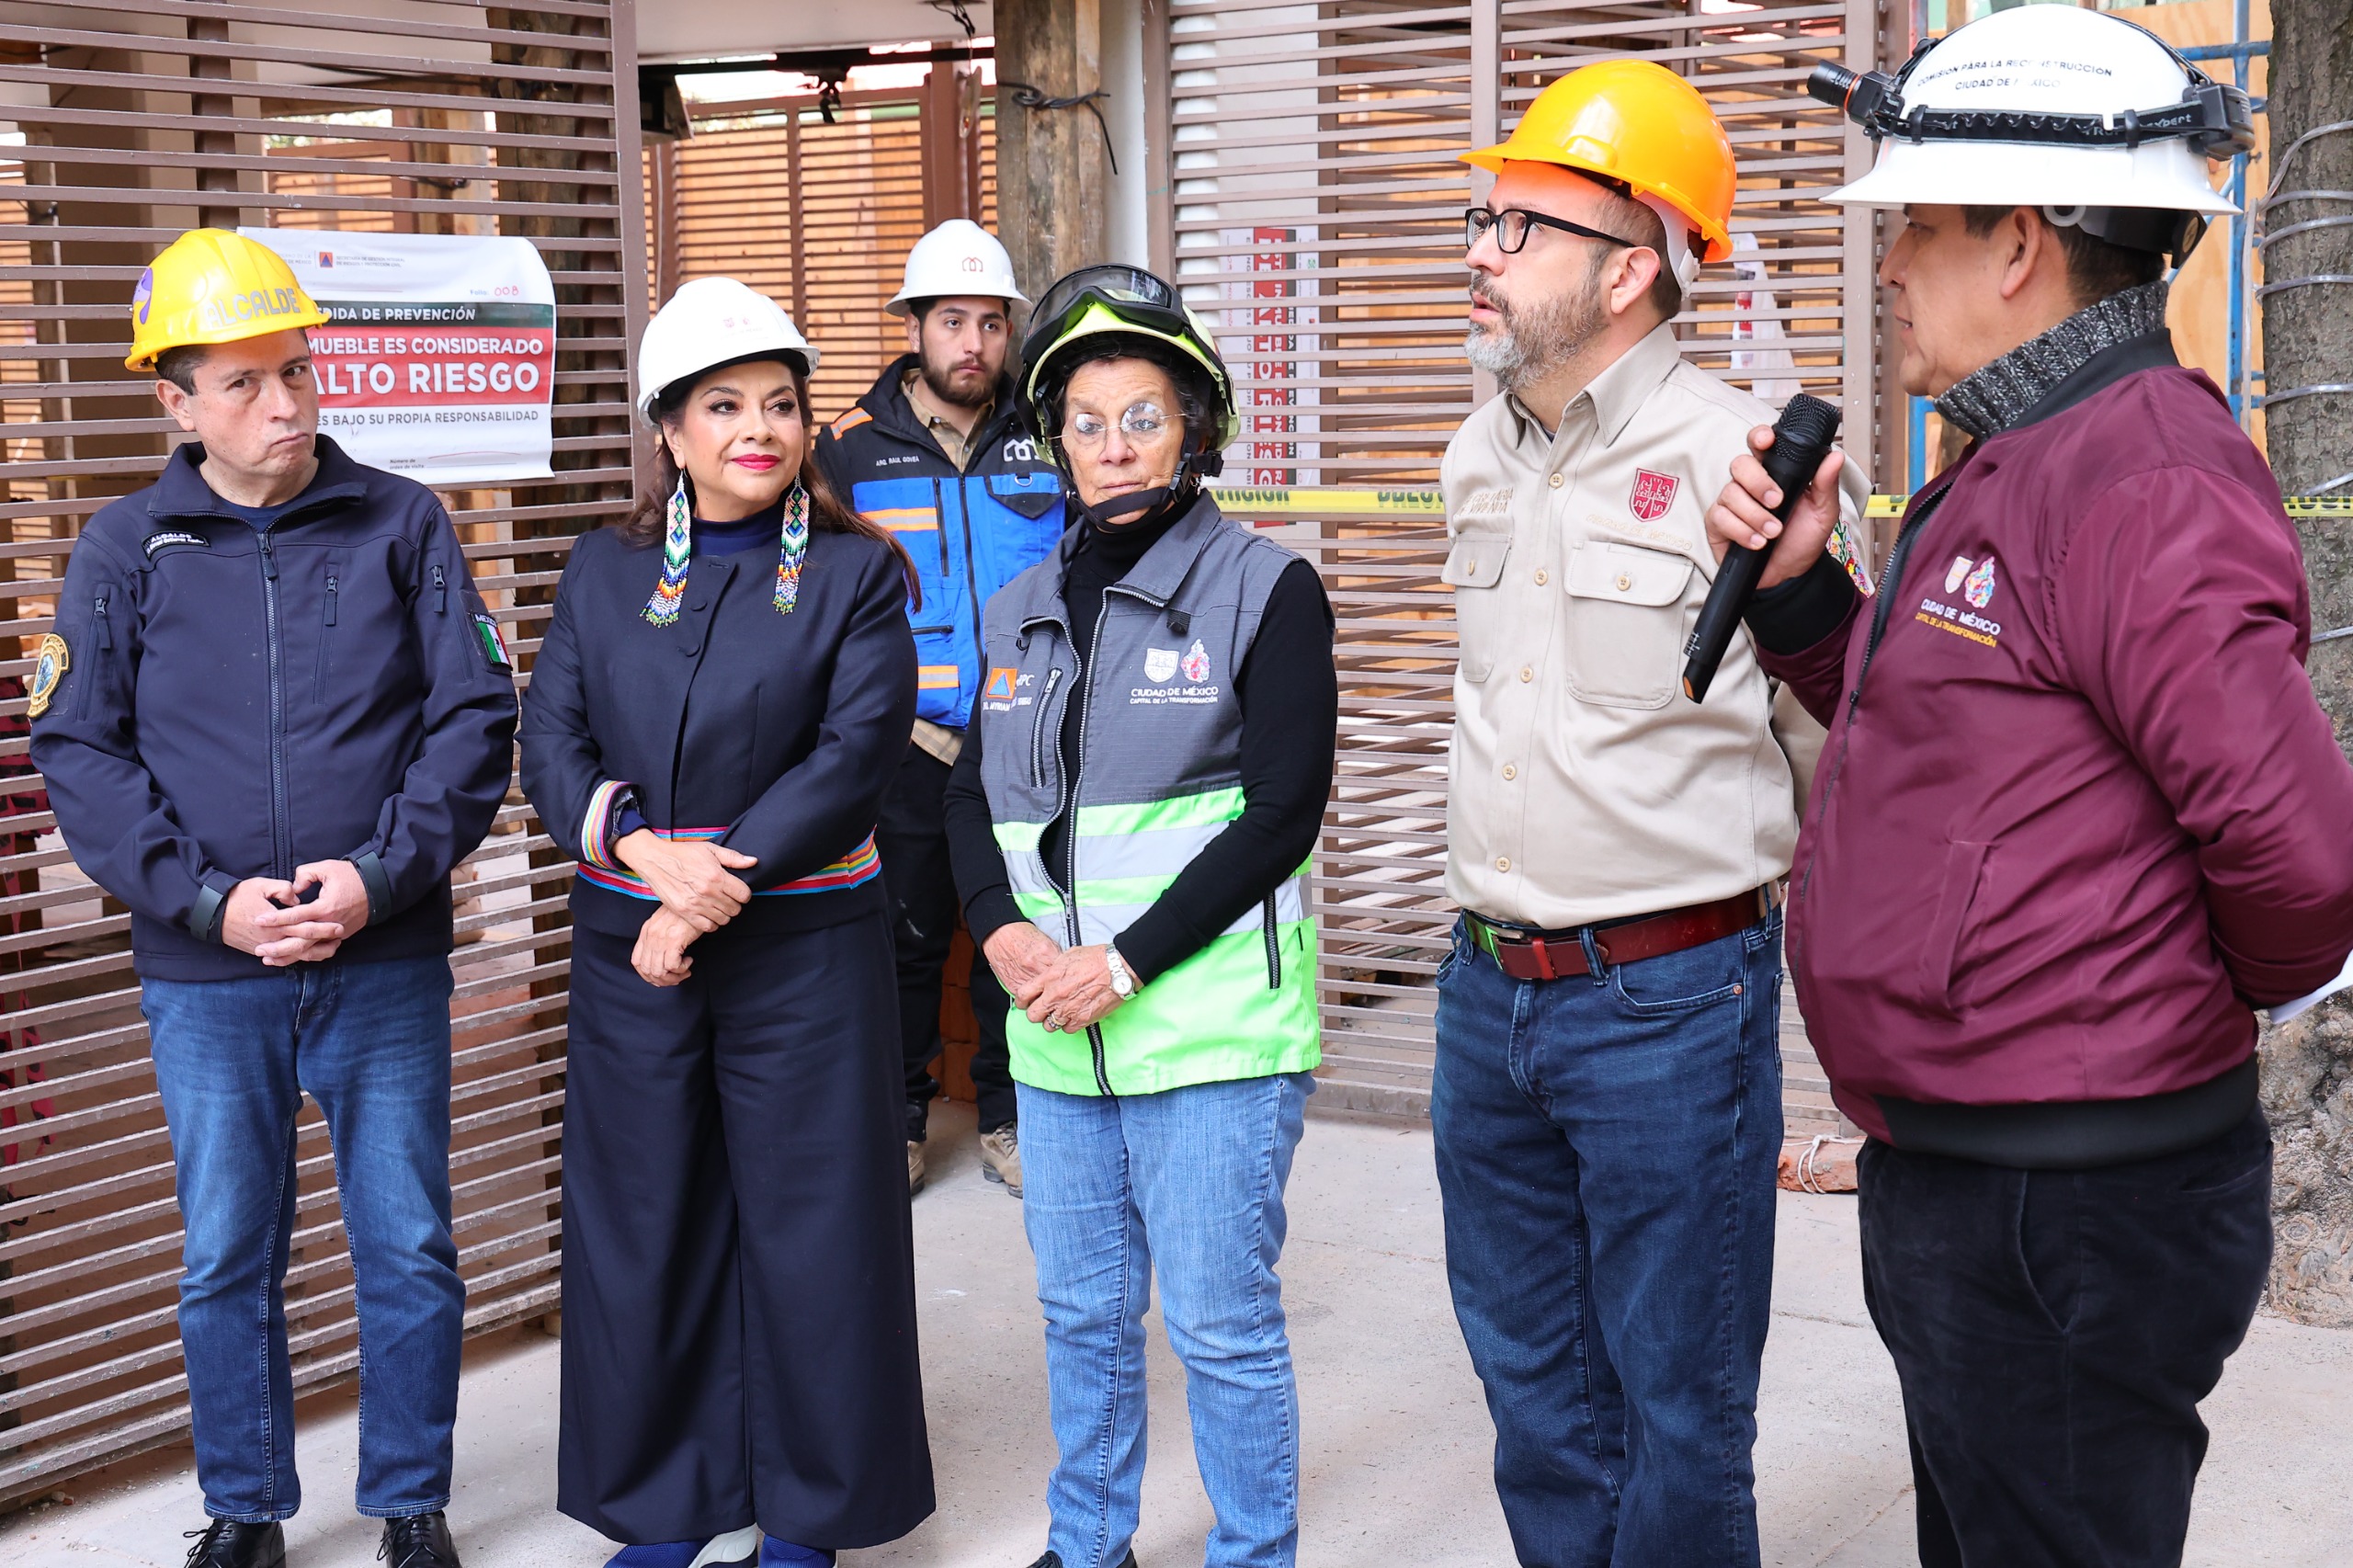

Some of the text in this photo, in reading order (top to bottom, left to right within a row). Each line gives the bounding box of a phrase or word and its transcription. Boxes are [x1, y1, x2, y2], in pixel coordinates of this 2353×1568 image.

[1961, 62, 1987, 72] PARA
[1990, 60, 2002, 68] LA
[1955, 78, 1994, 90] CIUDAD
[1996, 78, 2010, 86] DE
[494, 285, 520, 297] 008
[203, 288, 301, 330] ALCALDE
[361, 308, 381, 321] DE
[384, 303, 476, 322] PREVENCIÓN
[308, 336, 544, 356] MUEBLE ES CONSIDERADO
[407, 361, 540, 395] RIESGO
[333, 414, 366, 426] BAJO
[369, 414, 385, 425] SU
[387, 413, 432, 425] PROPIA
[435, 410, 540, 424] RESPONSABILIDAD
[1943, 606, 1959, 620] DE
[1958, 611, 2001, 636] MÉXICO
[1131, 685, 1220, 698] CIUDAD DE MÉXICO
[1168, 695, 1219, 704] TRANSFORMACIÓN
